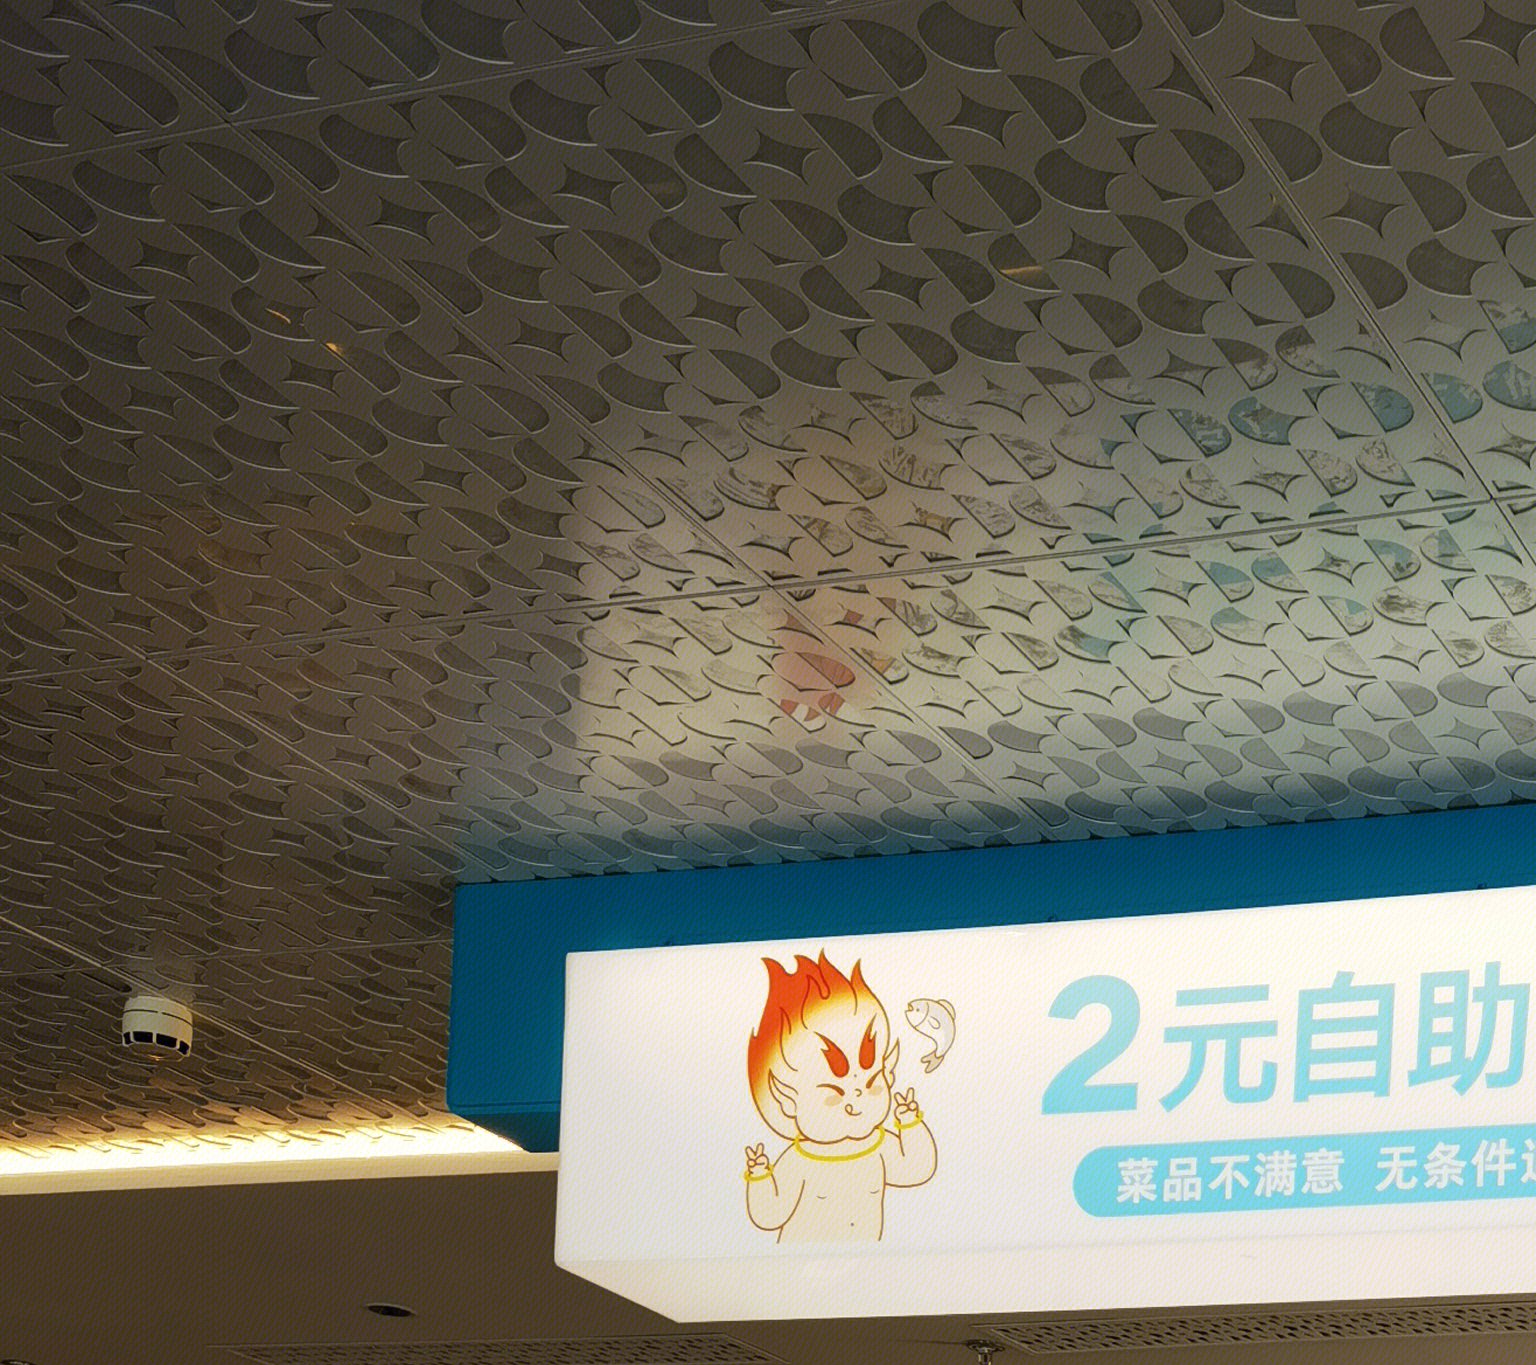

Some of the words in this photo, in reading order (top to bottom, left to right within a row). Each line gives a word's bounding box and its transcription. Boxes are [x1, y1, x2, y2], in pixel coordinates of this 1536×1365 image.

[1116, 1147, 1345, 1205] 菜品不满意
